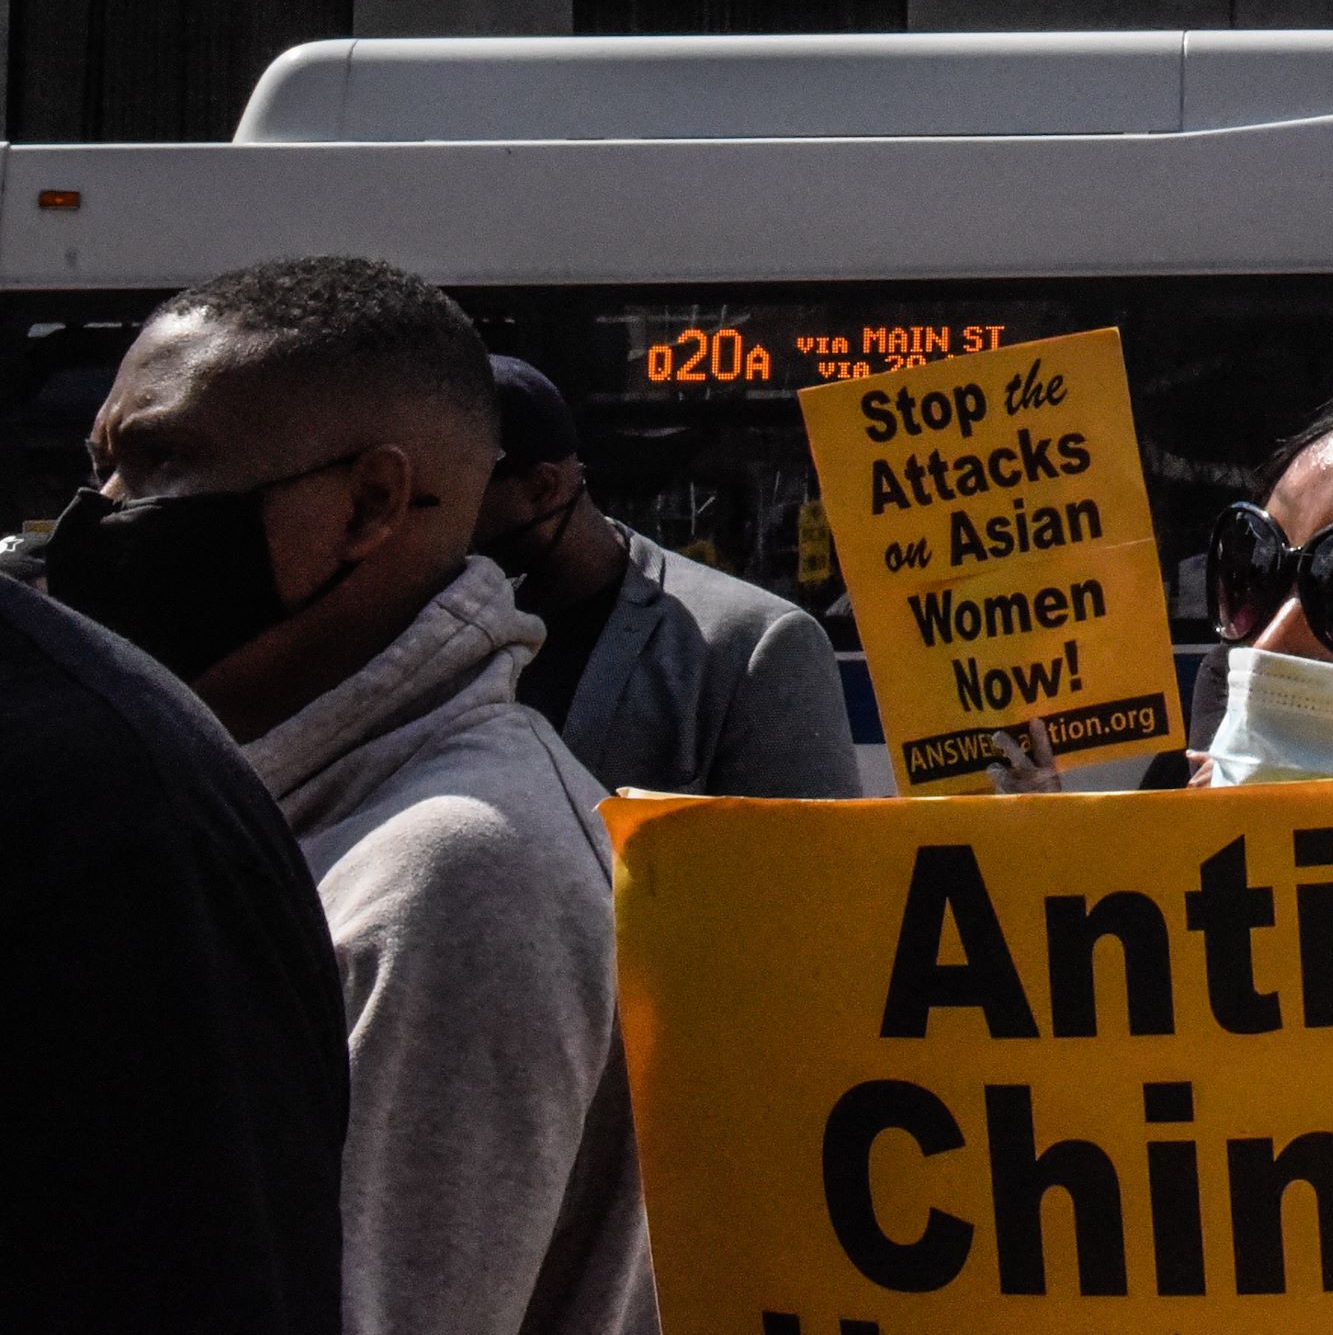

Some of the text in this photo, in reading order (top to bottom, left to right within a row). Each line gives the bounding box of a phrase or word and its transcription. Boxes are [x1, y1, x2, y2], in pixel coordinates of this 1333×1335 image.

[647, 325, 1006, 382] Q20A VIA MAIN ST
[818, 360, 870, 379] VIA
[860, 359, 1068, 443] Stop the
[872, 428, 1092, 516] Attacks
[884, 499, 1103, 574] on Asian
[907, 578, 1107, 650] Women
[953, 641, 1084, 713] Now!
